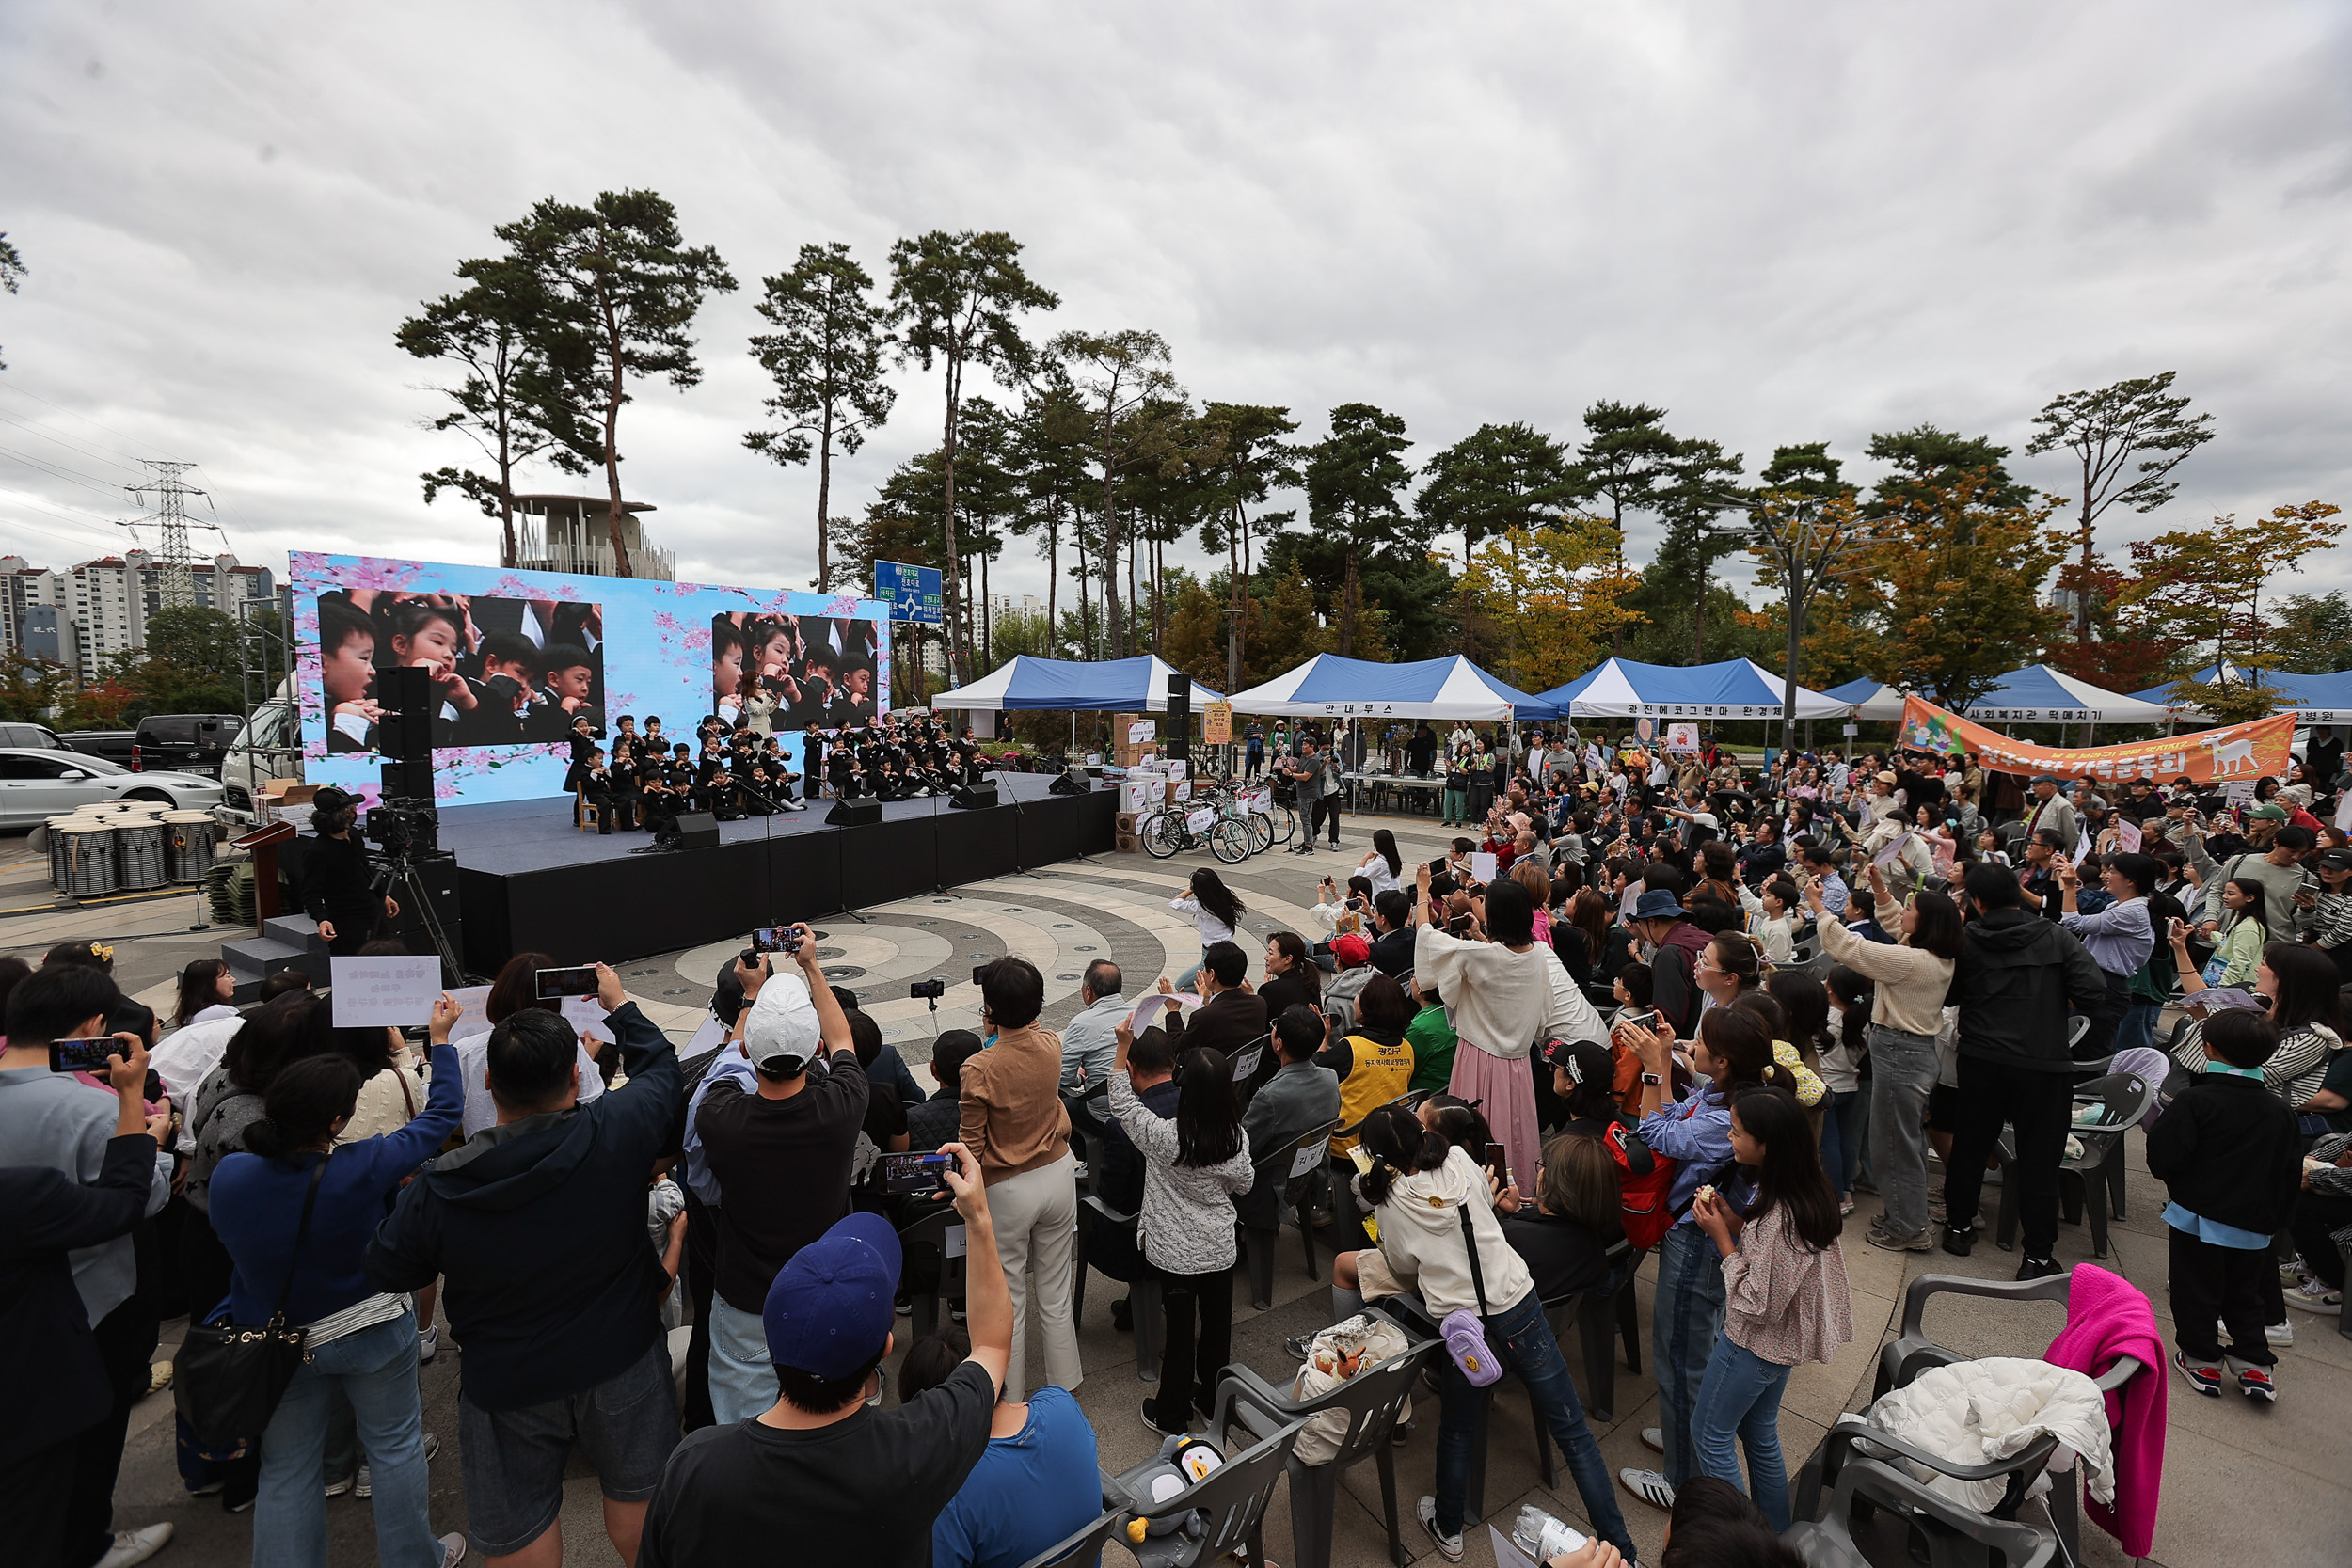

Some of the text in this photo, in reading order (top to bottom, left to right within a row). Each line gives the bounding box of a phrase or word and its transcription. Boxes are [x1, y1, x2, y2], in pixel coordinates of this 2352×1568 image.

[903, 567, 918, 577] 천호대교
[901, 578, 920, 588] 천호대로
[881, 589, 895, 598] 아차산
[1325, 704, 1392, 714] 안내부스
[1629, 705, 1728, 716] 광진에코그랜마
[2049, 710, 2102, 721] 떡메치기
[2070, 752, 2186, 780] 가족운동회
[1377, 1047, 1401, 1056] 광진구
